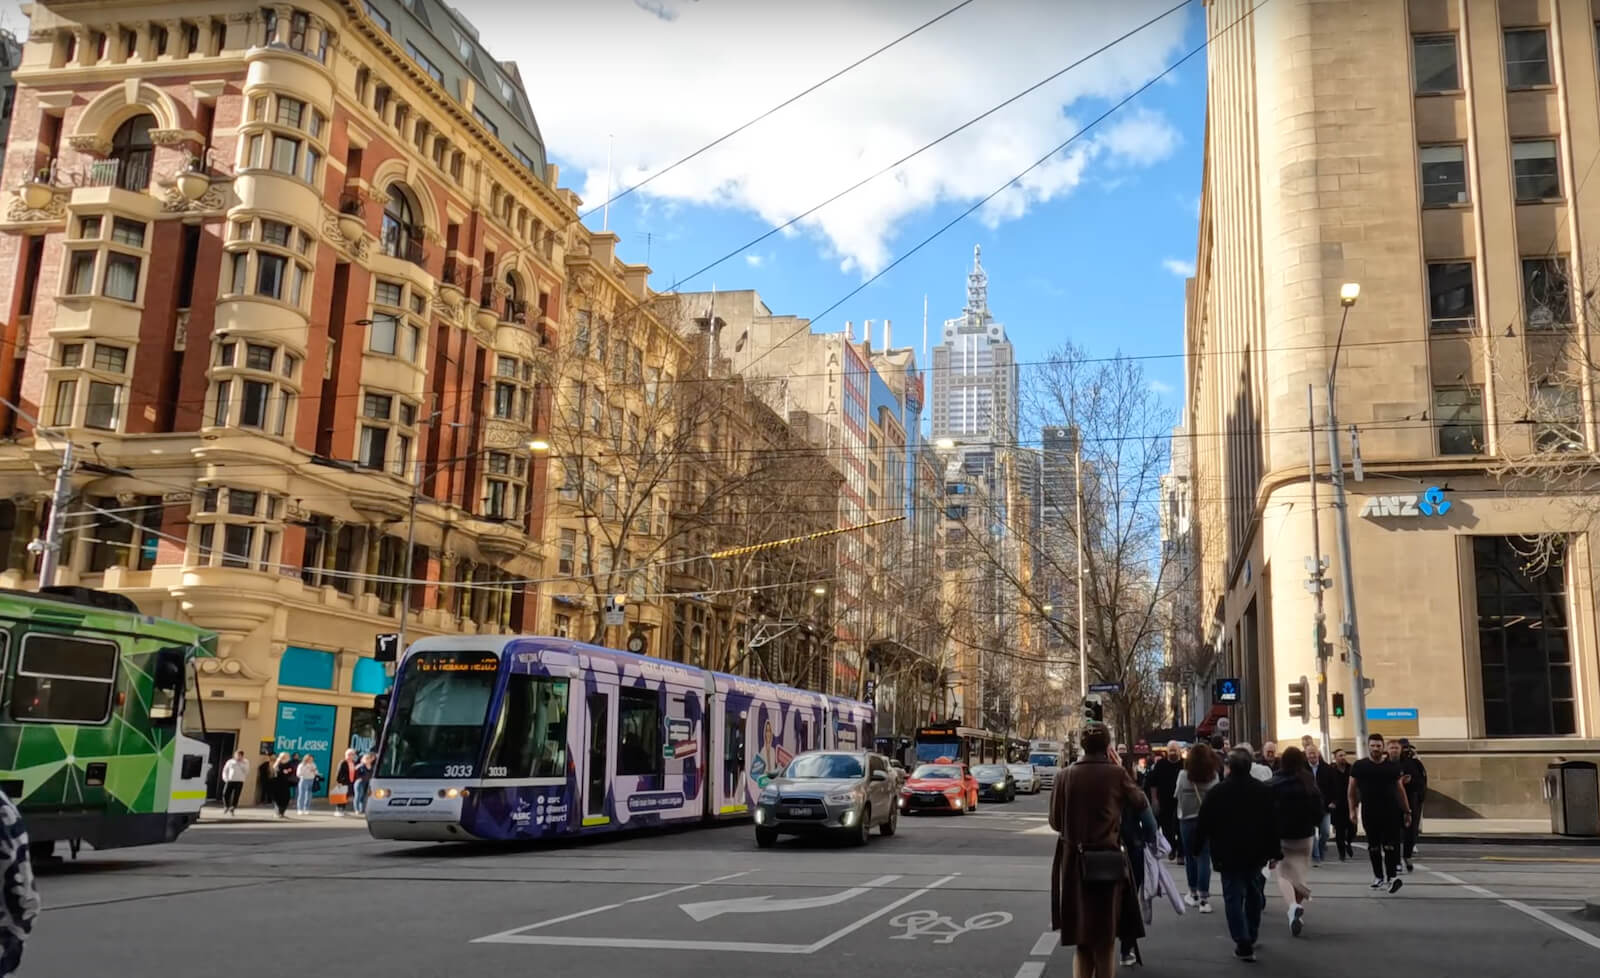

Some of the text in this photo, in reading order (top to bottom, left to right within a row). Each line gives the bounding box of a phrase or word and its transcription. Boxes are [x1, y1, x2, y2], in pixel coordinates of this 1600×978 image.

[1358, 495, 1419, 517] ANZ
[277, 736, 328, 751] For Lease
[444, 765, 473, 777] 3033
[488, 767, 507, 777] 3033
